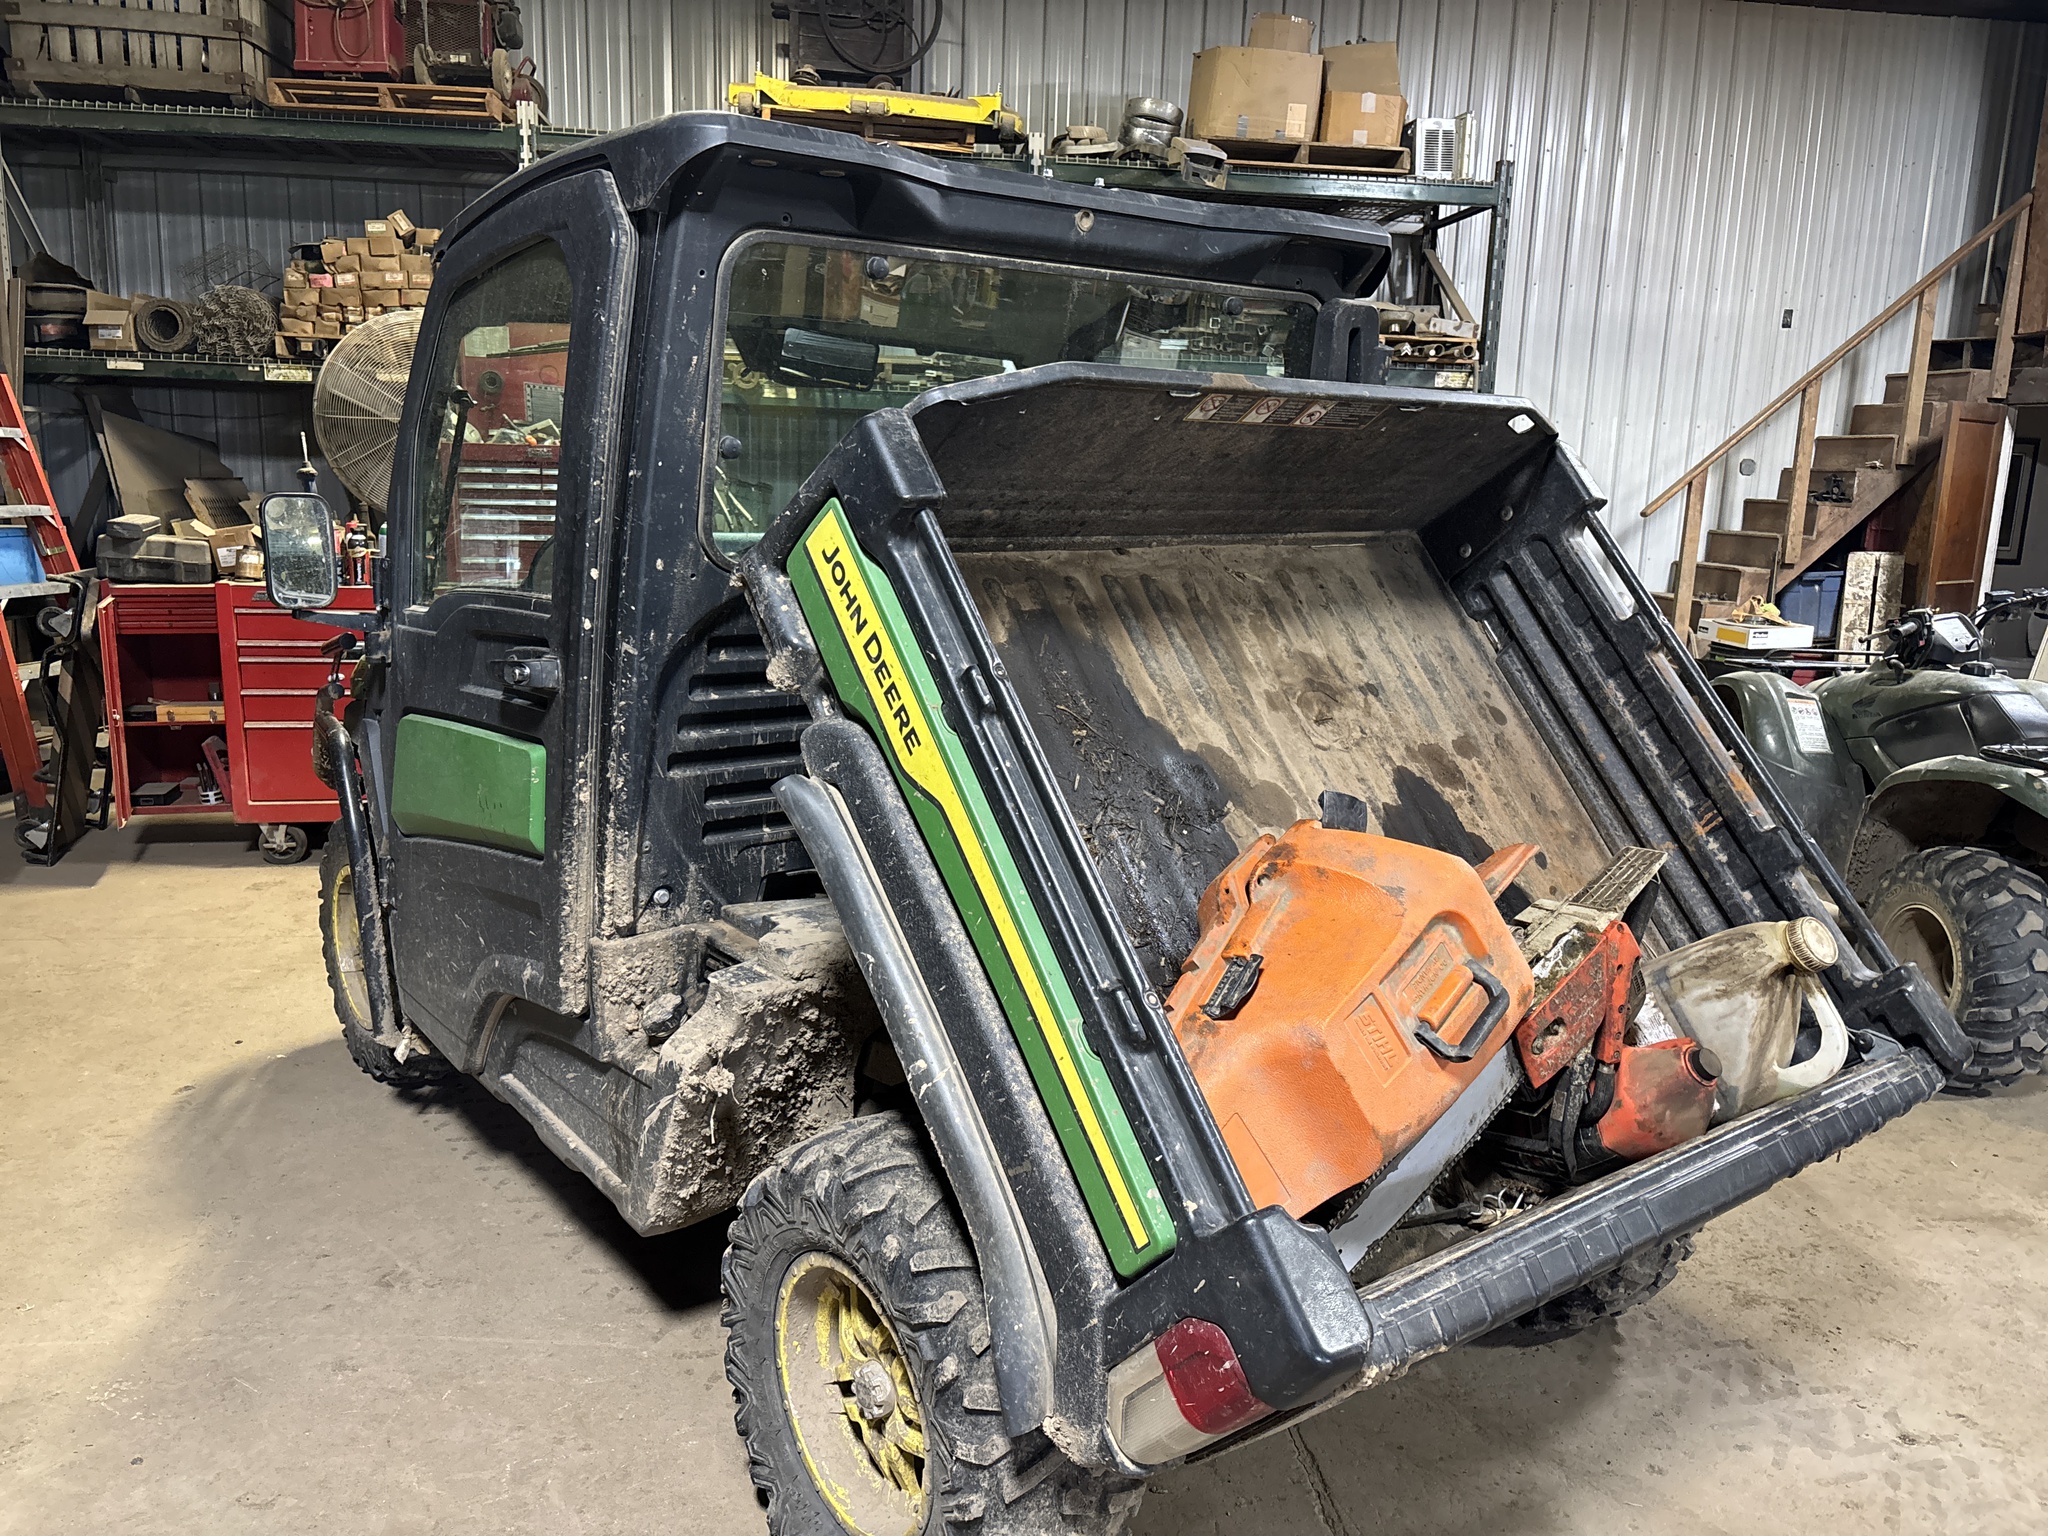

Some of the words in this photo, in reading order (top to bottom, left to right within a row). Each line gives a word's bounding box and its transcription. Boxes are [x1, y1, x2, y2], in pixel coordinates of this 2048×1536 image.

[822, 546, 868, 635] JOHN
[863, 631, 921, 756] DEERE
[1358, 1013, 1397, 1068] STIHL
